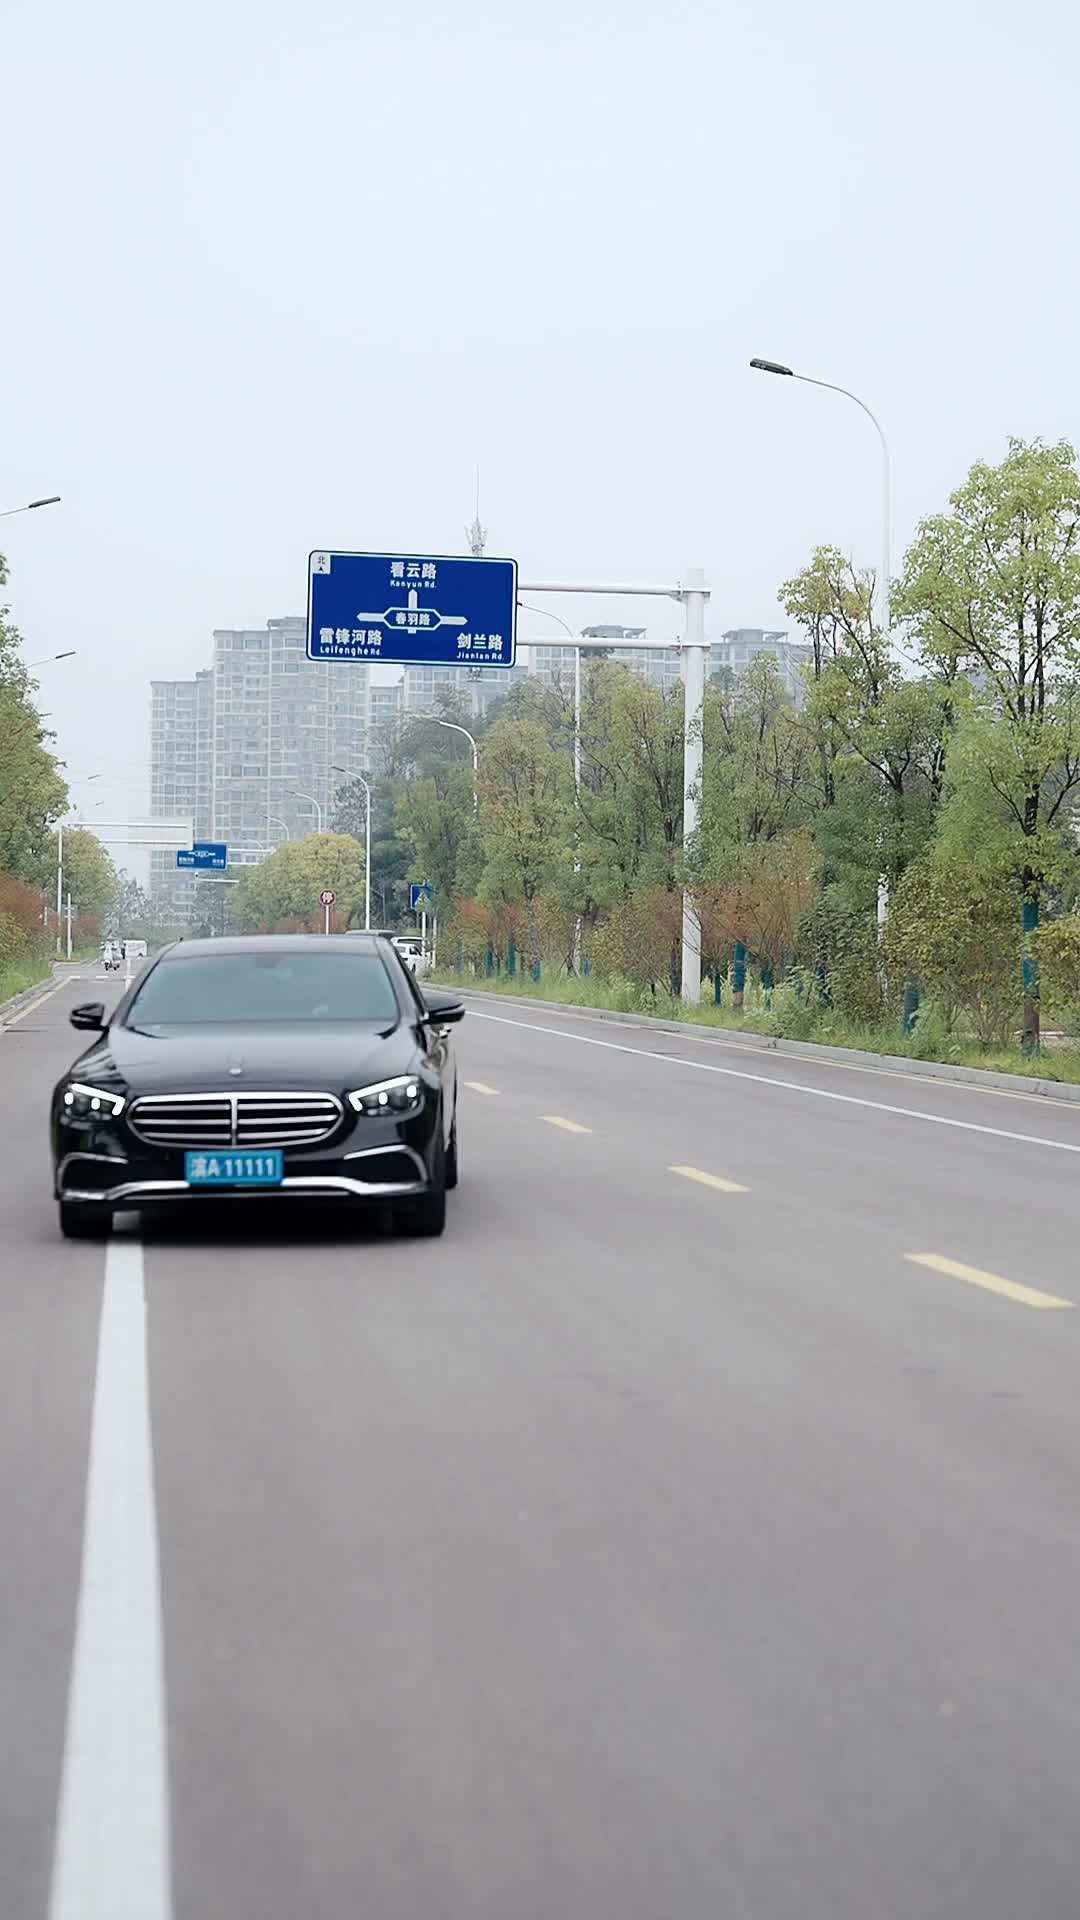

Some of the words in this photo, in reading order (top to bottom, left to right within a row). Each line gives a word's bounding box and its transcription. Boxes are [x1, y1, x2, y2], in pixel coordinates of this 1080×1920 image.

[390, 561, 437, 579] 看云路
[390, 580, 422, 589] Kanyun
[319, 627, 383, 646] 雷锋河路
[456, 632, 503, 651] 剑兰路
[456, 651, 490, 660] Jianlan
